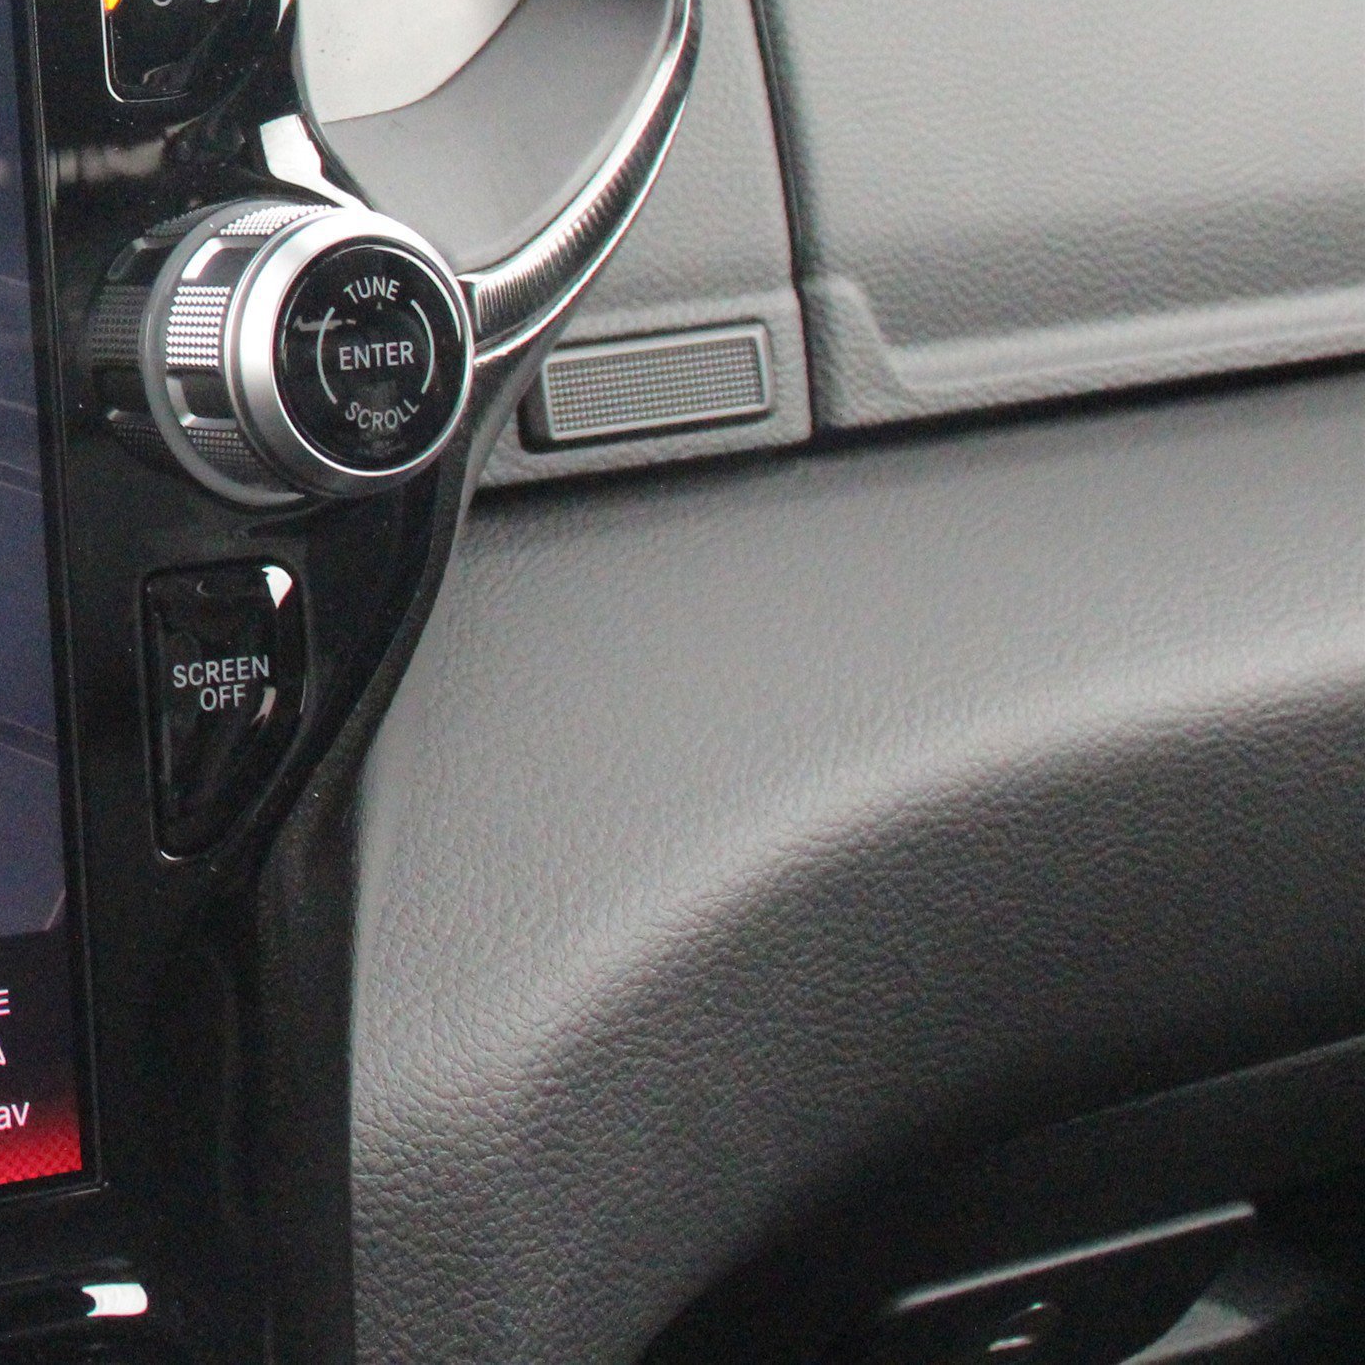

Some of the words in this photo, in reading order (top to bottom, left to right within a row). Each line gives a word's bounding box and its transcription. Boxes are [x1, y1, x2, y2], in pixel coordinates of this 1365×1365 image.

[344, 276, 400, 304] TUNE
[339, 341, 414, 371] ENTER
[345, 397, 420, 432] SCROLL
[172, 656, 269, 687] SCREEN
[200, 685, 246, 711] OFF
